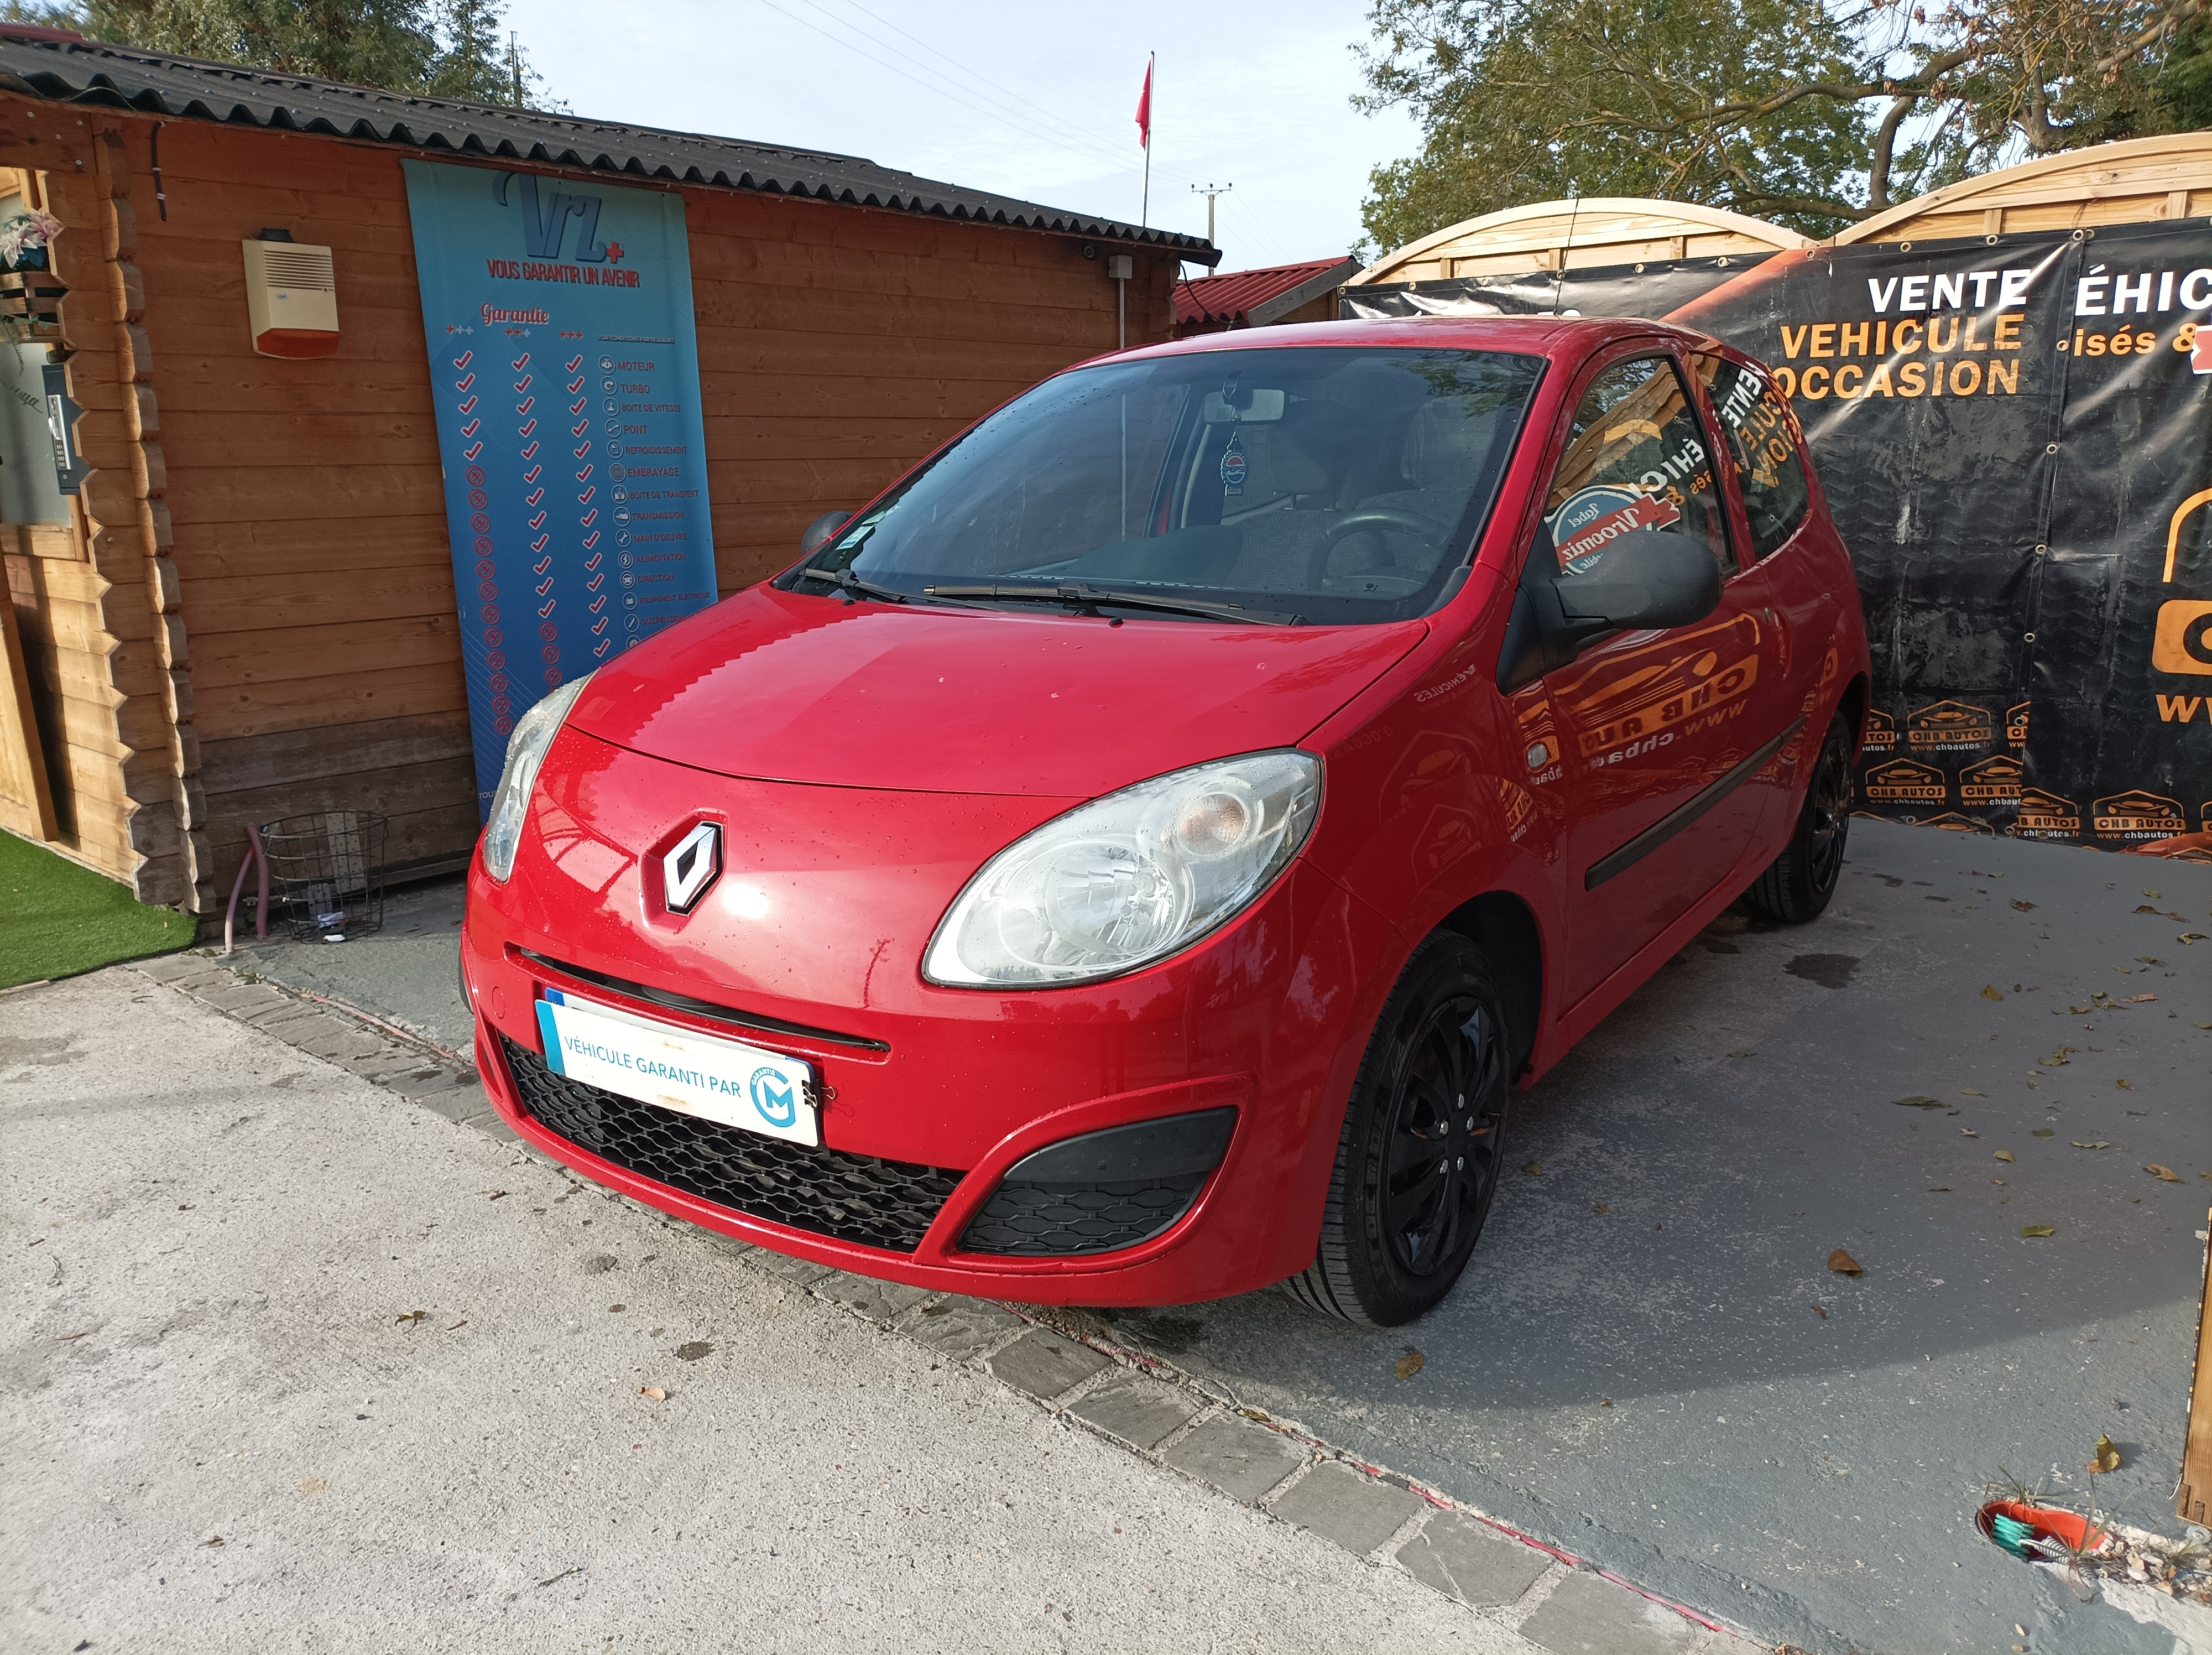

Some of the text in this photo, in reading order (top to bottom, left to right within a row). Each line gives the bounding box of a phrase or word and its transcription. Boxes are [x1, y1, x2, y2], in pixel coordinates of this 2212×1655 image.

[486, 258, 640, 288] VOUS GARANTIR UN AVENIR
[1867, 269, 2031, 313] VENTE
[480, 302, 550, 327] Garantie
[1780, 314, 2025, 359] VEHICULE
[2074, 322, 2197, 356] isés &
[618, 361, 655, 371] MOTEUR
[1772, 359, 2020, 400] OCCASION
[620, 384, 650, 394] TURBO
[623, 425, 648, 434] PONT
[625, 446, 687, 455] REFROIDISSEMENT
[627, 467, 680, 477] EMBRAYAGE
[630, 491, 650, 499] BOITE
[633, 511, 685, 521] TRANSMISSION
[634, 533, 687, 543] MAIN D'OEUVRE
[637, 553, 687, 563] ALIMENTATION
[638, 574, 674, 583] DIRECTION
[1913, 730, 1988, 741] CHB AUTOS
[1871, 788, 1943, 796] CHB AUTOS
[1965, 787, 1994, 795] CHB
[2034, 817, 2077, 828] AUTOS
[2099, 818, 2182, 829] CHB AUTOS
[564, 1036, 742, 1097] VÉHICULE GARANTI PAR
[751, 1068, 776, 1086] GARANTIE
